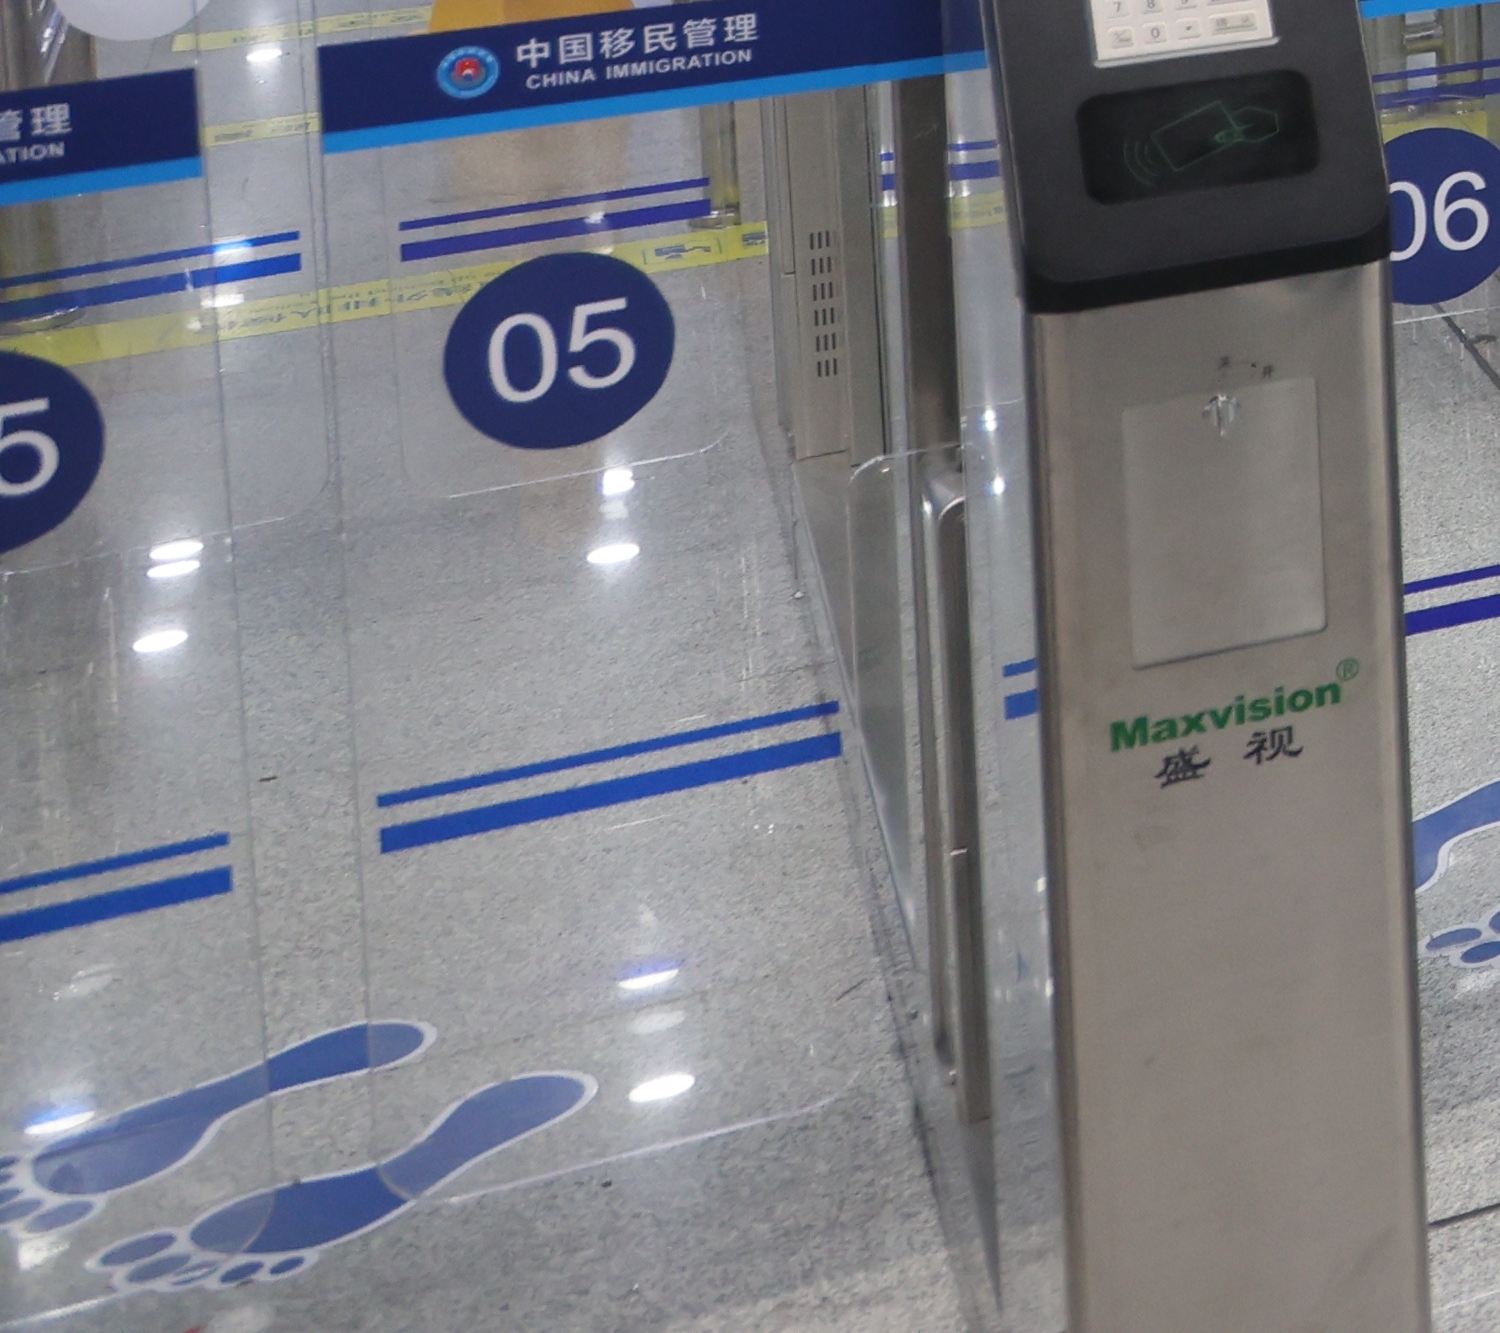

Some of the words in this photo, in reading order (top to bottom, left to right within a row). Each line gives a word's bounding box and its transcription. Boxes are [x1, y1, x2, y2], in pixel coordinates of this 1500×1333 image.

[1112, 1, 1122, 14] 7
[1150, 27, 1160, 38] 0
[516, 12, 759, 69] 中国移民管理
[525, 67, 597, 90] CHINA
[605, 49, 753, 81] IMMIGRATION
[1390, 169, 1491, 262] 06
[486, 296, 637, 404] 05
[1110, 679, 1342, 754] Maxvision
[1154, 725, 1303, 789] 盛视
